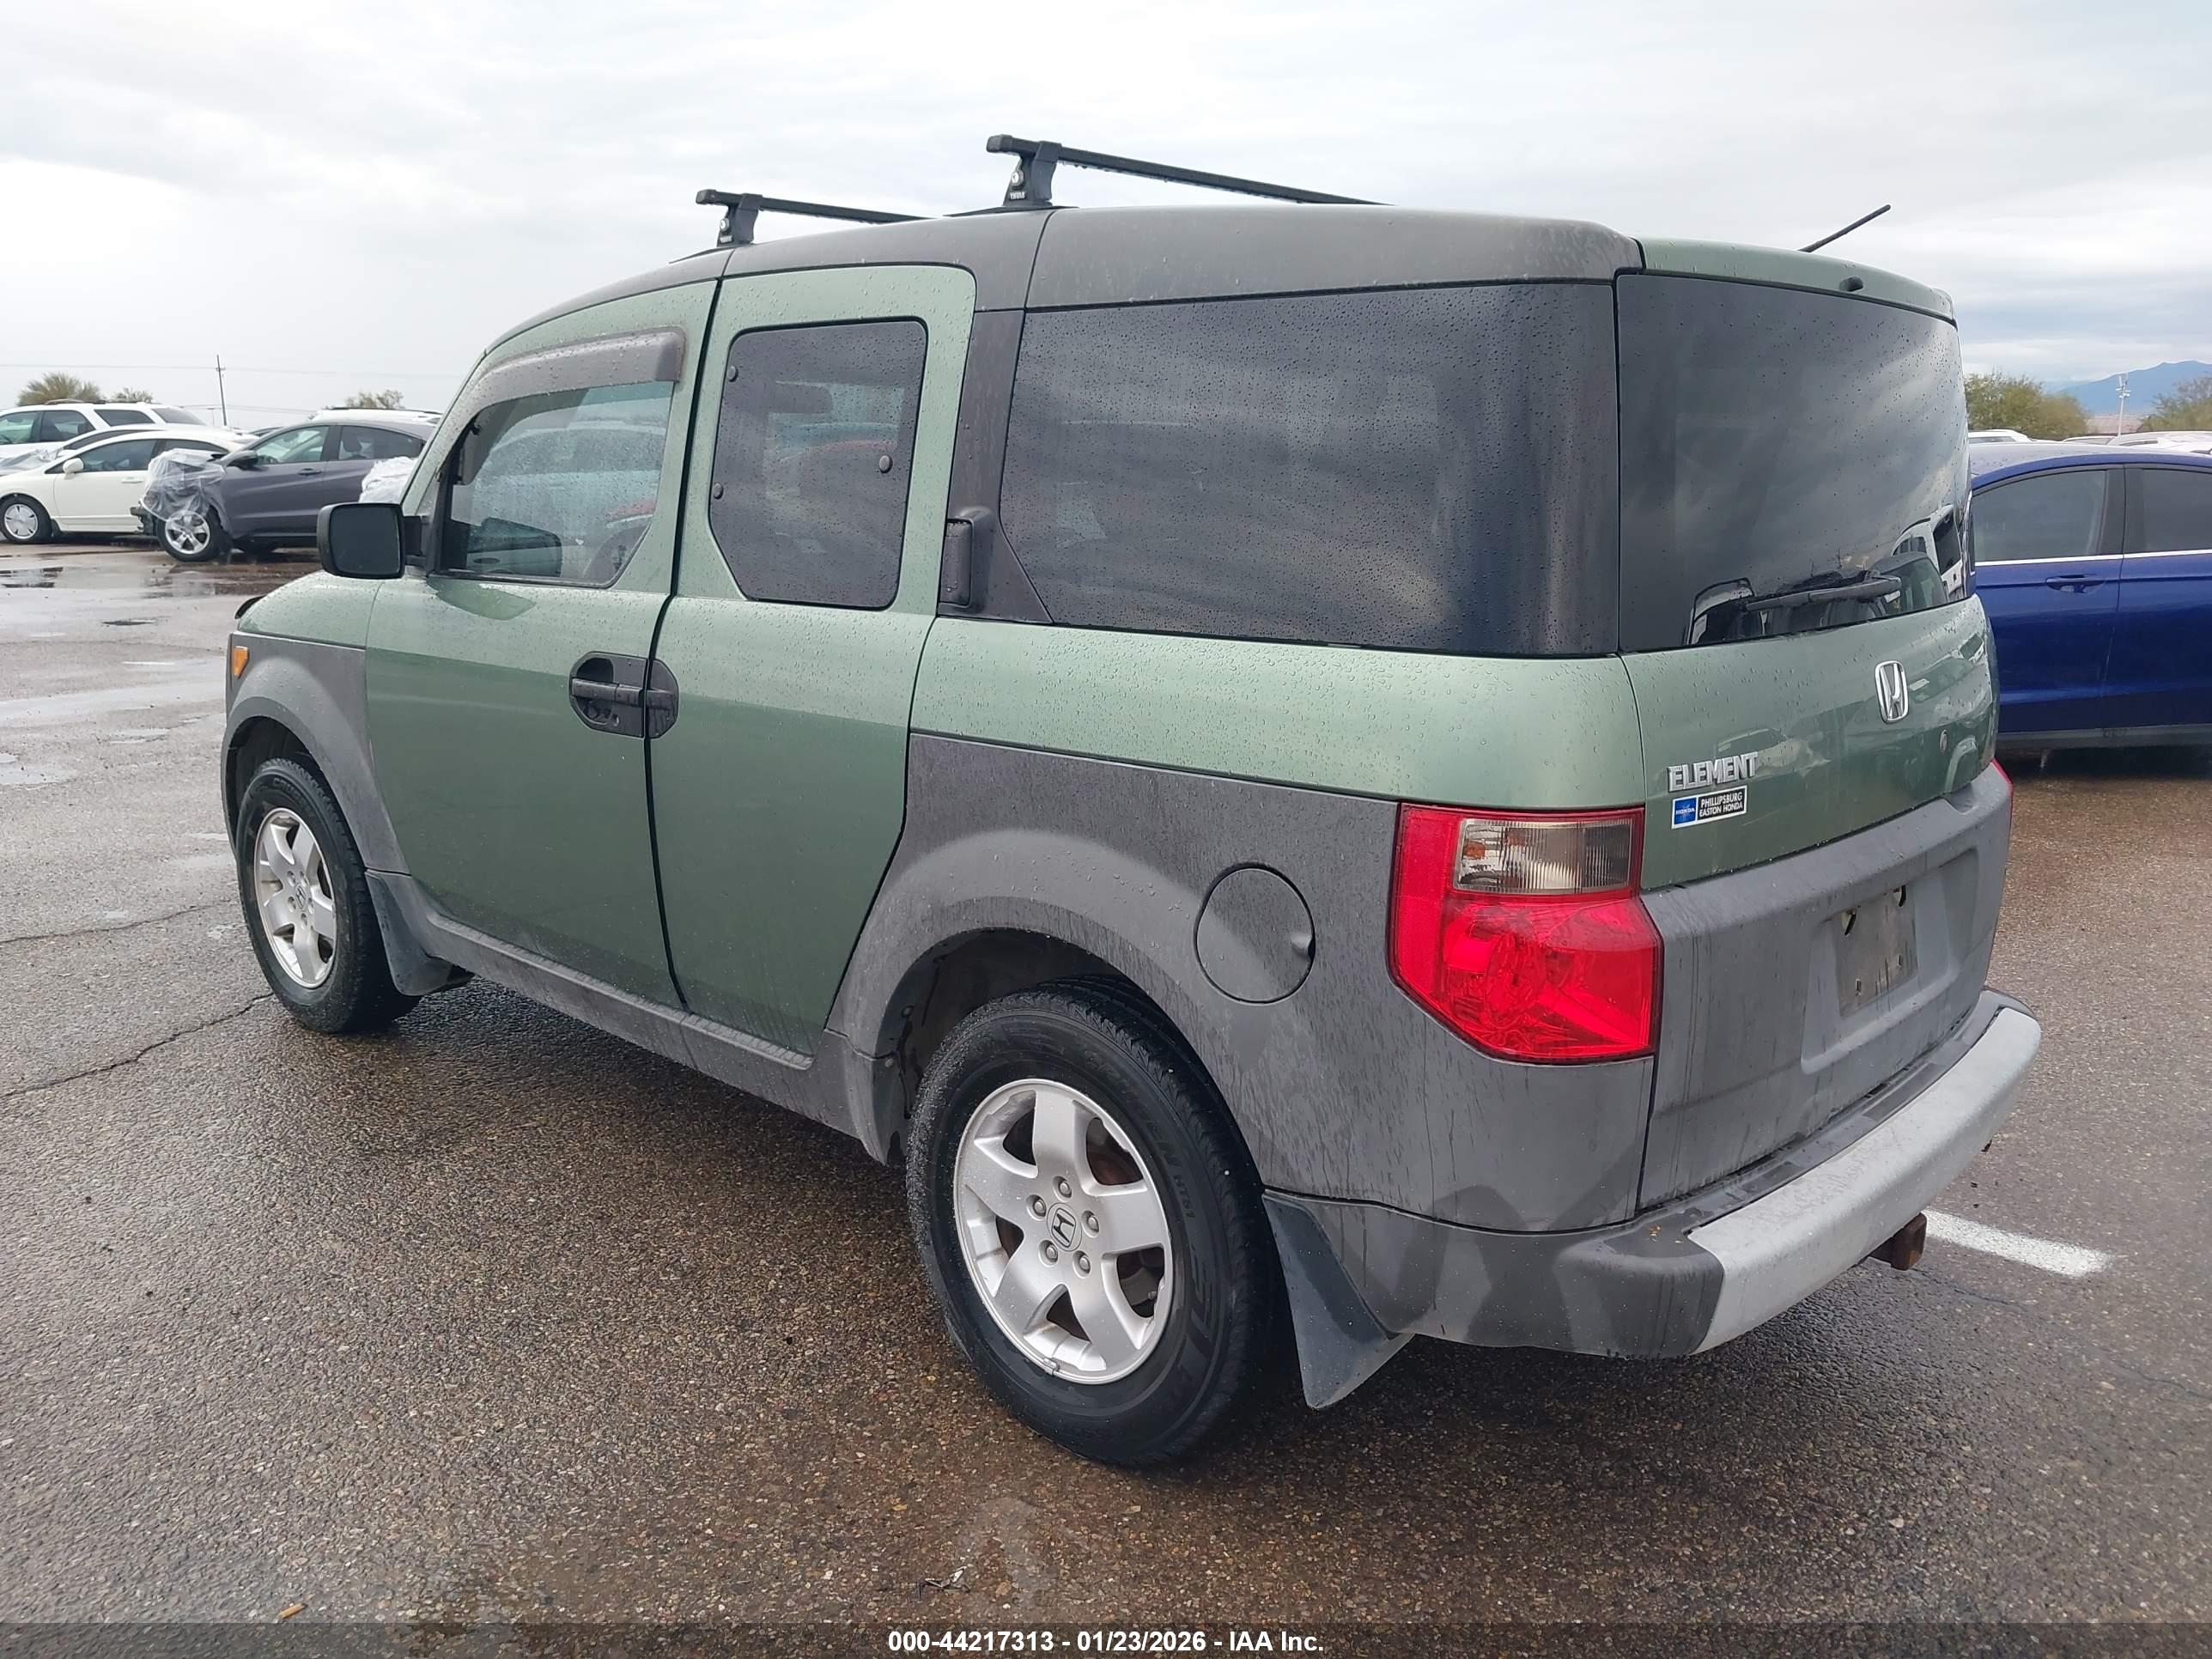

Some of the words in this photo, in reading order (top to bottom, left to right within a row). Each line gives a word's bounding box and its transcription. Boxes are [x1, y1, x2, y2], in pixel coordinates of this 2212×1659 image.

[1668, 751, 1759, 792] ELEMENT
[1700, 792, 1742, 808] PHILLIPSBURG
[1699, 805, 1722, 817] EASTON
[1723, 801, 1743, 812] HONDA
